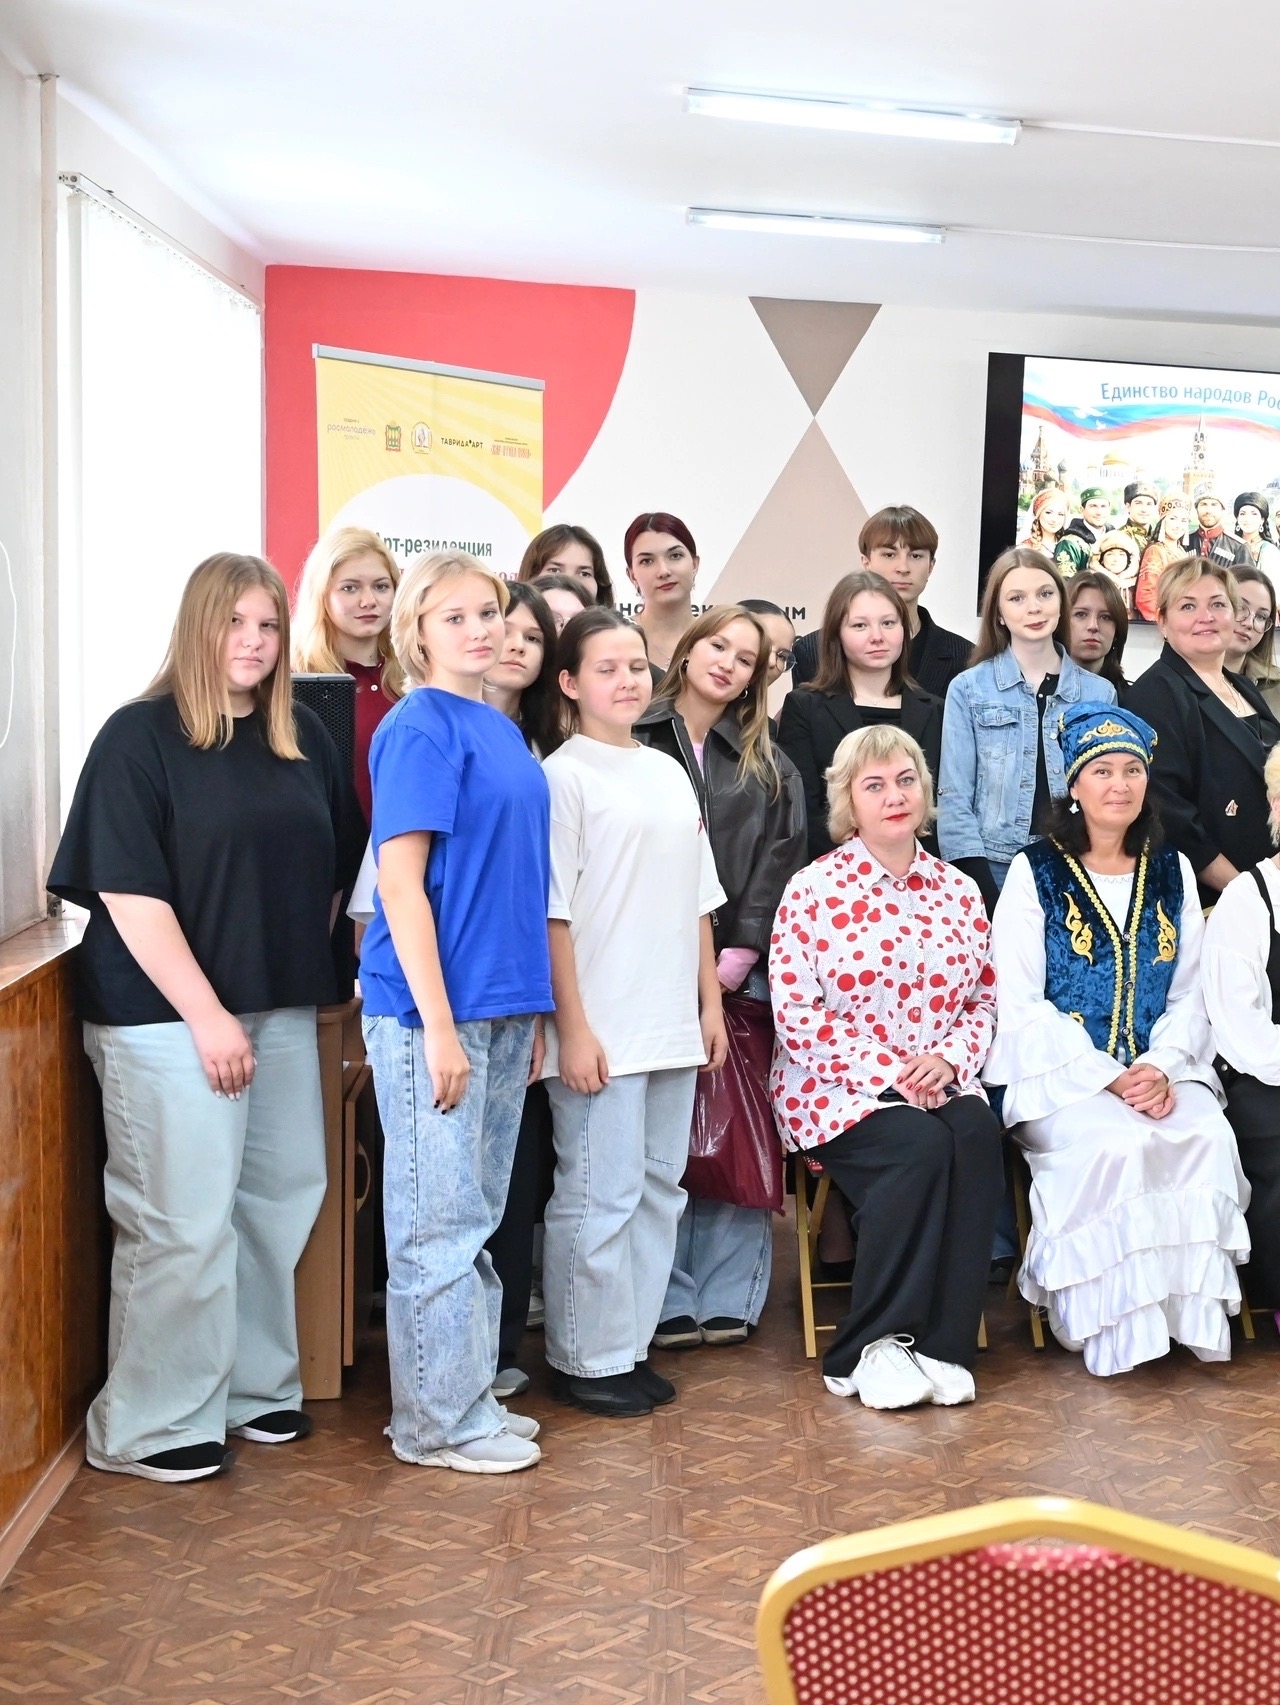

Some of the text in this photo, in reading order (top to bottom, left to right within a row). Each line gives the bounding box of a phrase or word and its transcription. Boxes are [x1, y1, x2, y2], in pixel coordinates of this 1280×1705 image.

[1101, 383, 1178, 402] Единство
[1183, 386, 1252, 404] народов
[375, 532, 492, 558] рт-резиденция
